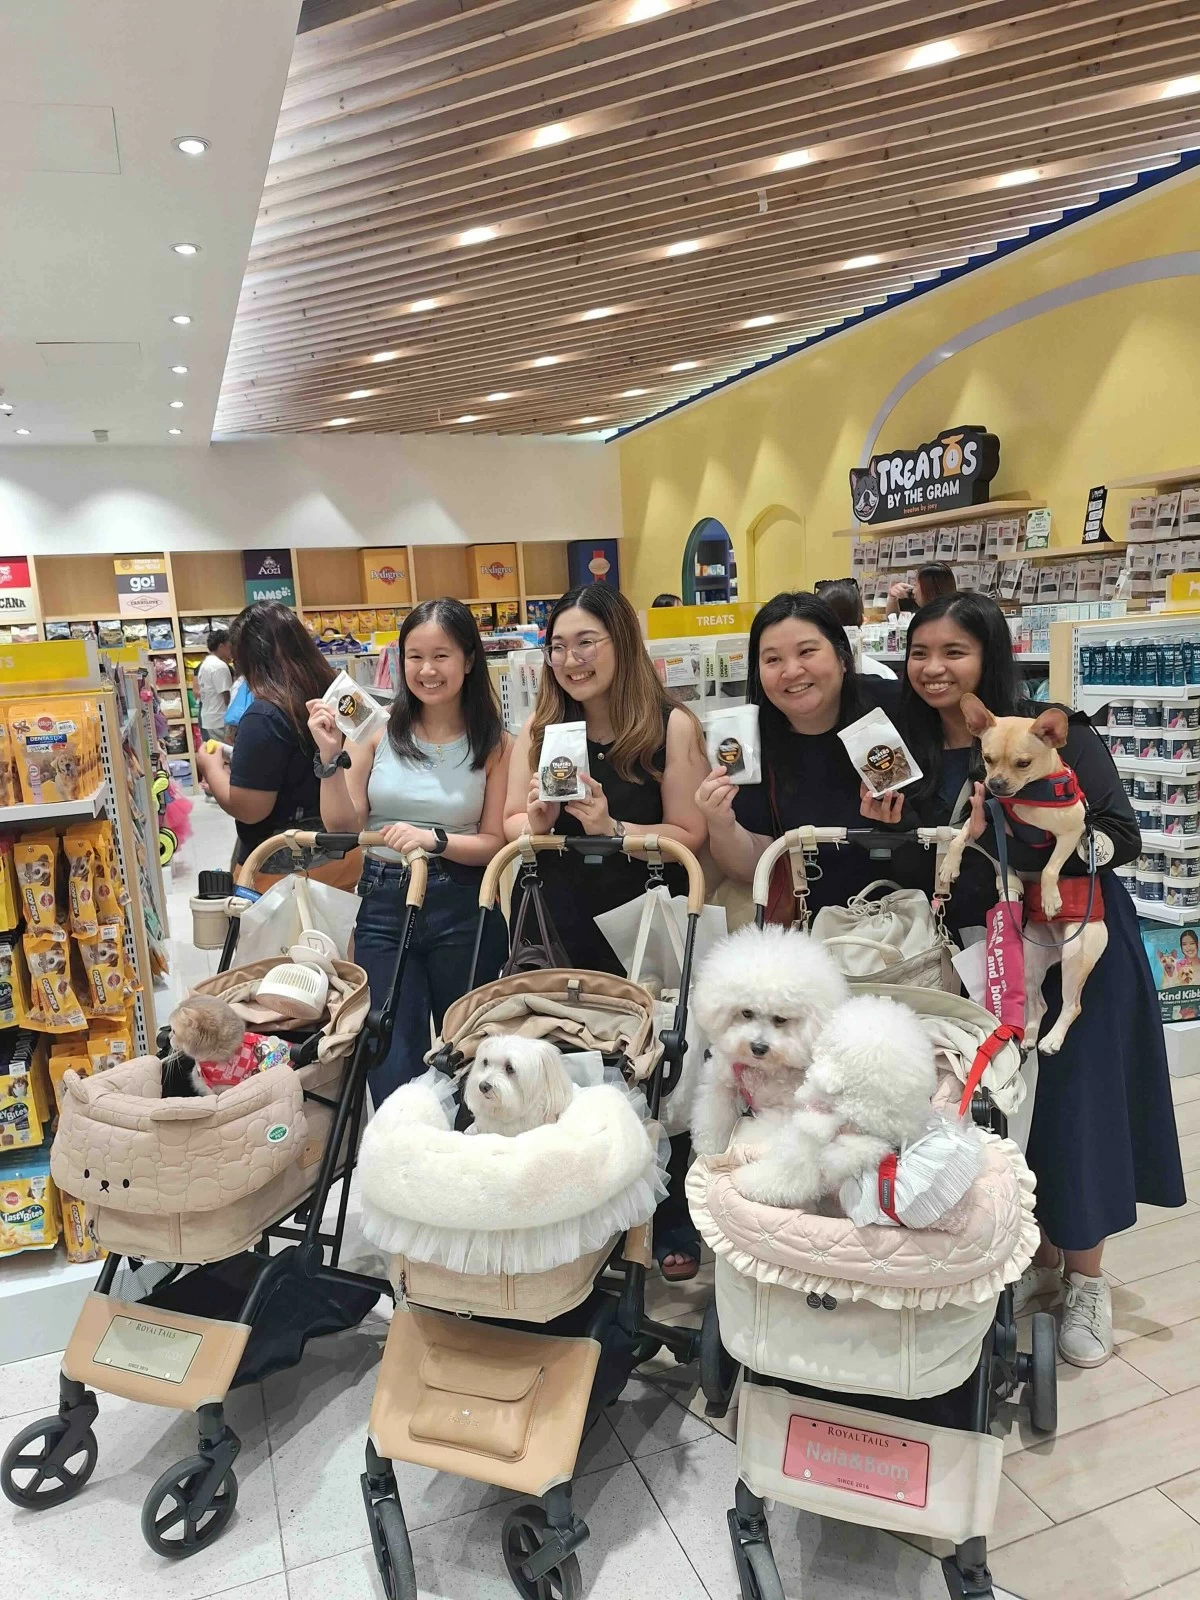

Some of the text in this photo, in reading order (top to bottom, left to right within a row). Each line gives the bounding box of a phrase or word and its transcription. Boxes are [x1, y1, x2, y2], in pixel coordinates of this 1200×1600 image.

[877, 434, 978, 495] TREATOS
[887, 479, 960, 509] BY THE GRAM
[258, 564, 281, 575] Aozi
[370, 569, 405, 580] Pedigree
[480, 565, 513, 575] Pedigree
[129, 575, 156, 592] go!
[253, 589, 283, 601] IAMS
[696, 614, 735, 626] TREATS
[1158, 990, 1182, 1001] Kind
[805, 1440, 909, 1482] Nala&Bom
[837, 1477, 870, 1490] SINCE 2016
